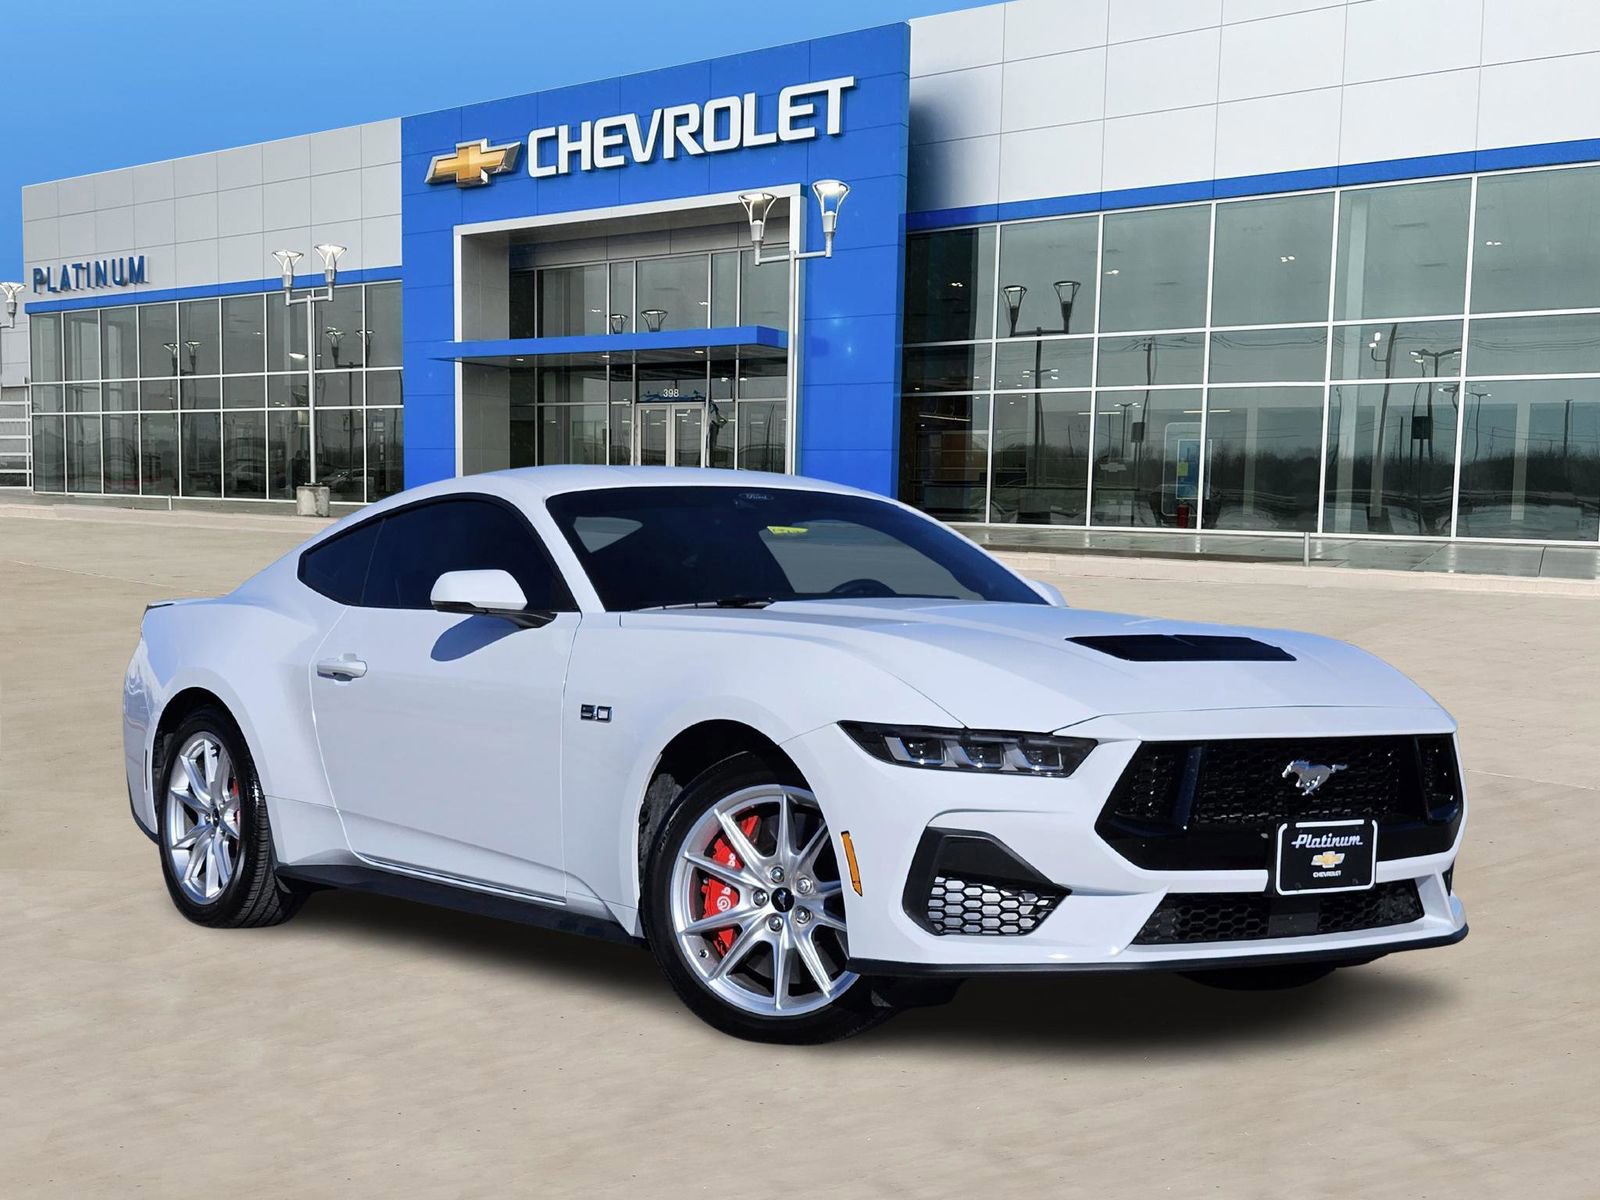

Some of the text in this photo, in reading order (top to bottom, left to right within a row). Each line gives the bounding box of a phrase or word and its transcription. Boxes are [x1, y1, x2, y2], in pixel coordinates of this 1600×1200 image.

[527, 76, 855, 178] CHEVROLET
[33, 255, 146, 294] PLATINUM
[663, 388, 679, 398] 398
[1291, 832, 1364, 849] Platinum
